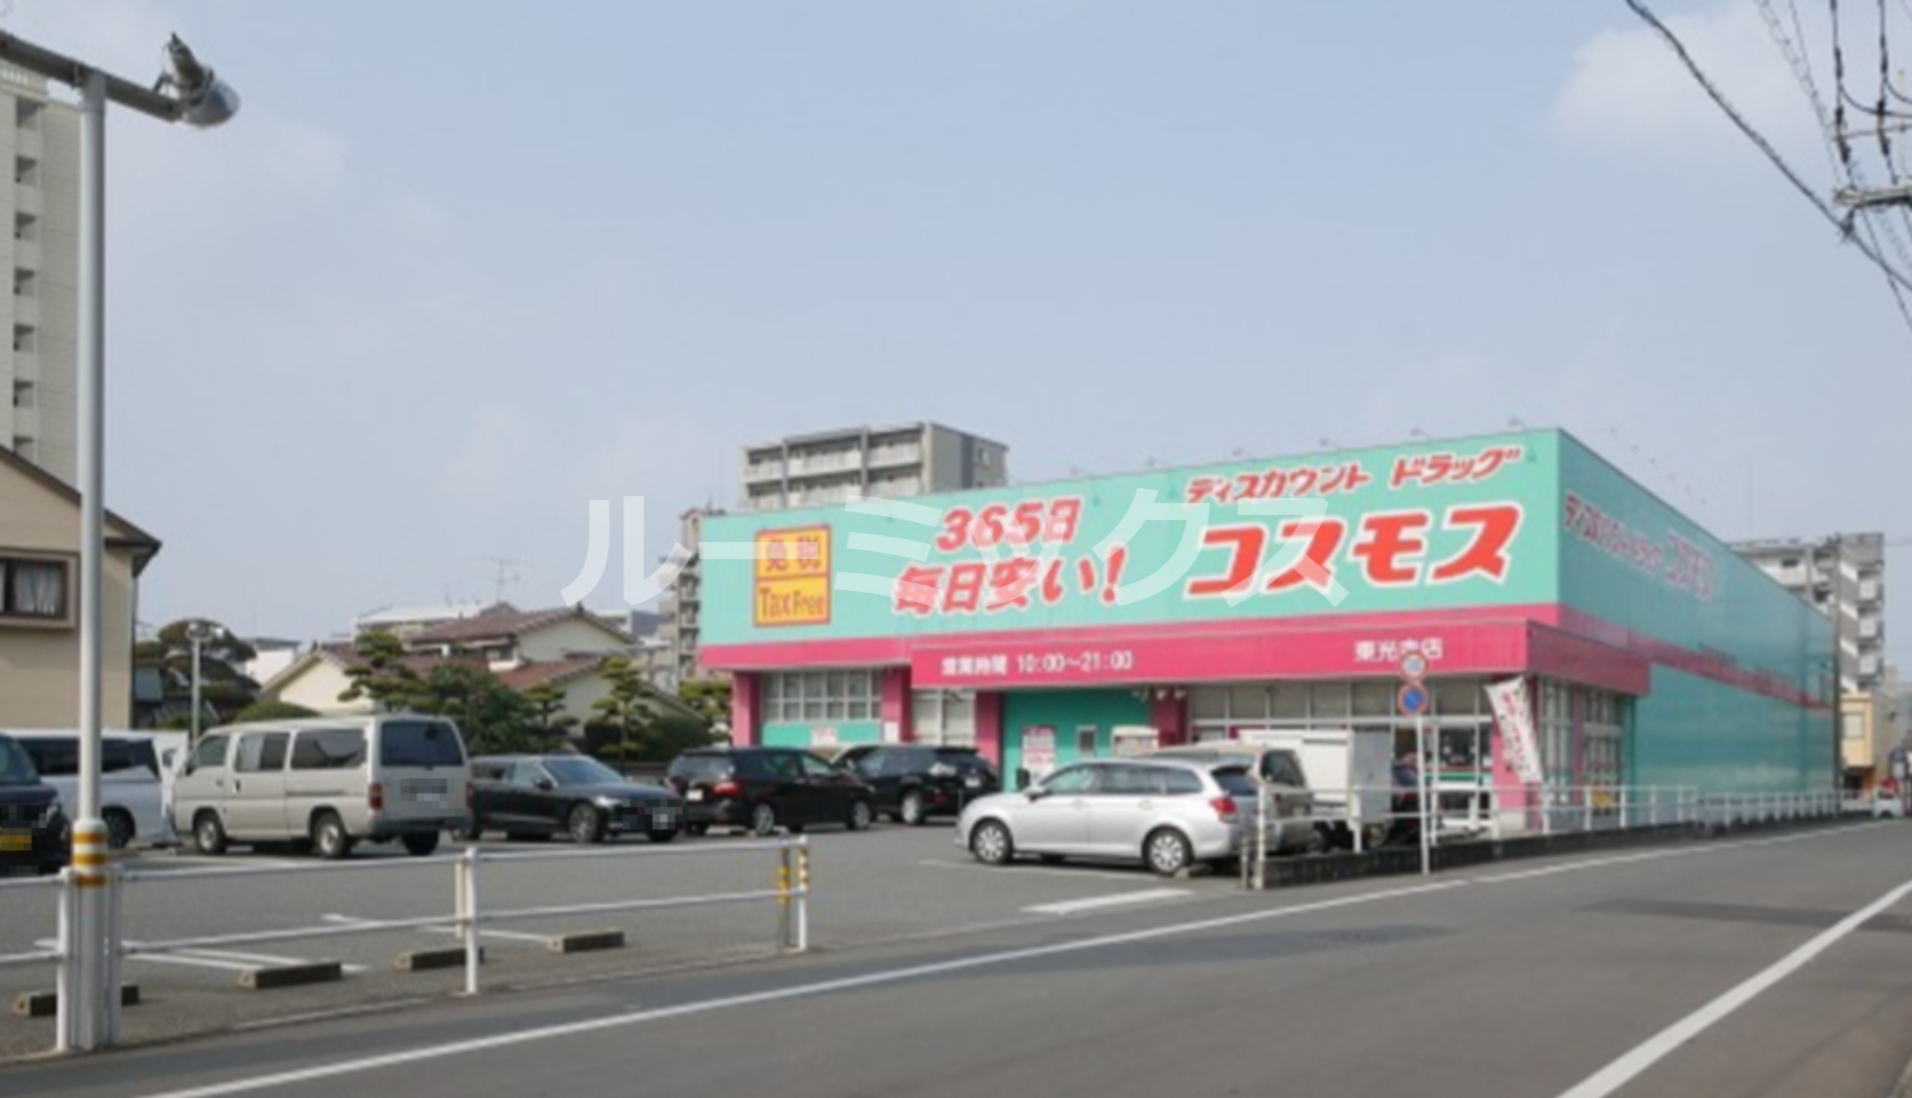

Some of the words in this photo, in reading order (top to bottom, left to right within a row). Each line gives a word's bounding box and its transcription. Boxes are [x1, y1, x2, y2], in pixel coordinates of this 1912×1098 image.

[1187, 463, 1371, 504] ディスカウント
[1390, 448, 1522, 488] ドラッグ
[936, 497, 1082, 551] 365日
[1185, 503, 1523, 600] コスモス
